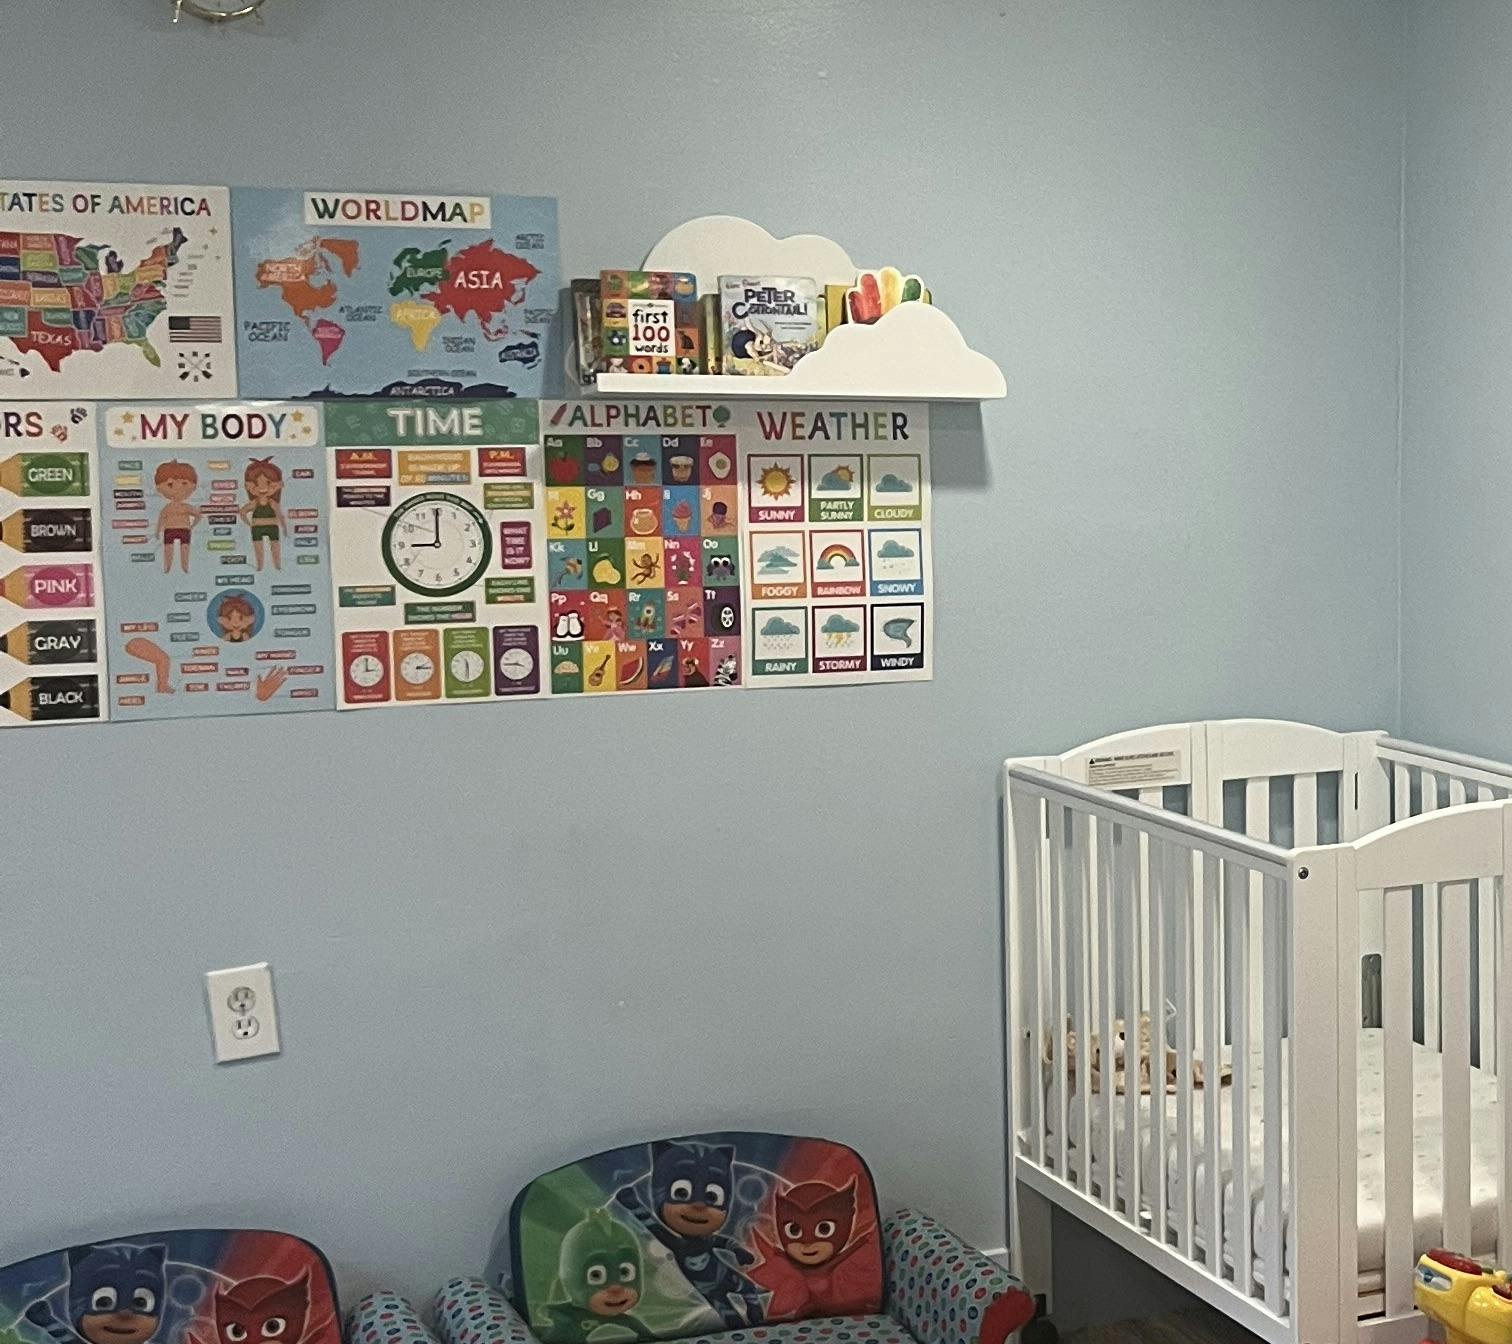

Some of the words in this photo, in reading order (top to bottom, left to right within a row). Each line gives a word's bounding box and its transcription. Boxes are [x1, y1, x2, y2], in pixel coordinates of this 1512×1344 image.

[72, 194, 101, 213] OF
[108, 195, 212, 217] AMERICA
[406, 267, 443, 278] EUROPE
[454, 271, 503, 289] ASIA
[744, 287, 795, 304] PETER
[632, 309, 668, 324] first
[244, 322, 290, 332] PACIFIC
[632, 324, 670, 342] 100
[31, 331, 72, 346] TEXAS
[248, 332, 288, 342] OCEAN
[634, 344, 669, 353] words
[390, 385, 454, 397] ANTARCTICA
[387, 407, 483, 436] TIME
[569, 405, 712, 428] ALPHABET
[140, 413, 190, 440] MY
[201, 413, 287, 439] BODY
[757, 411, 910, 441] WEATHER
[586, 437, 602, 448] Bb
[624, 436, 639, 448] Cc
[663, 437, 679, 448] Dd
[28, 467, 73, 482] GREEN
[587, 488, 605, 502] Gg
[625, 489, 642, 501] Hh
[820, 501, 855, 511] PARTLY
[416, 512, 426, 521] 11
[758, 509, 796, 521] SUNNY
[820, 511, 854, 520] SUNNY
[874, 508, 914, 519] CLOUDY
[30, 523, 77, 537] BROWN
[464, 523, 471, 532] 2
[398, 541, 405, 550] 9
[470, 539, 477, 548] 3
[550, 542, 566, 553] Kk
[664, 539, 680, 550] Nn
[703, 538, 719, 549] Oo
[466, 556, 473, 564] 4
[417, 568, 424, 577] 7
[435, 573, 443, 582] 6
[453, 568, 460, 576] 5
[34, 579, 77, 594] PINK
[762, 585, 799, 597] FOGGY
[816, 586, 862, 596] RAINBOW
[877, 583, 917, 594] SNOWY
[551, 593, 567, 605] Pp
[589, 592, 609, 604] Qq
[629, 592, 641, 603] Rr
[666, 591, 680, 603] Ss
[704, 589, 717, 600] Tt
[34, 636, 82, 652] GRAY
[553, 644, 569, 656] Uu
[648, 640, 664, 652] Xx
[680, 639, 694, 652] Yy
[711, 638, 726, 650] Zz
[765, 661, 798, 672] RAINY
[819, 659, 862, 671] STORMY
[880, 657, 915, 668] WINDY
[39, 691, 84, 706] BLACK
